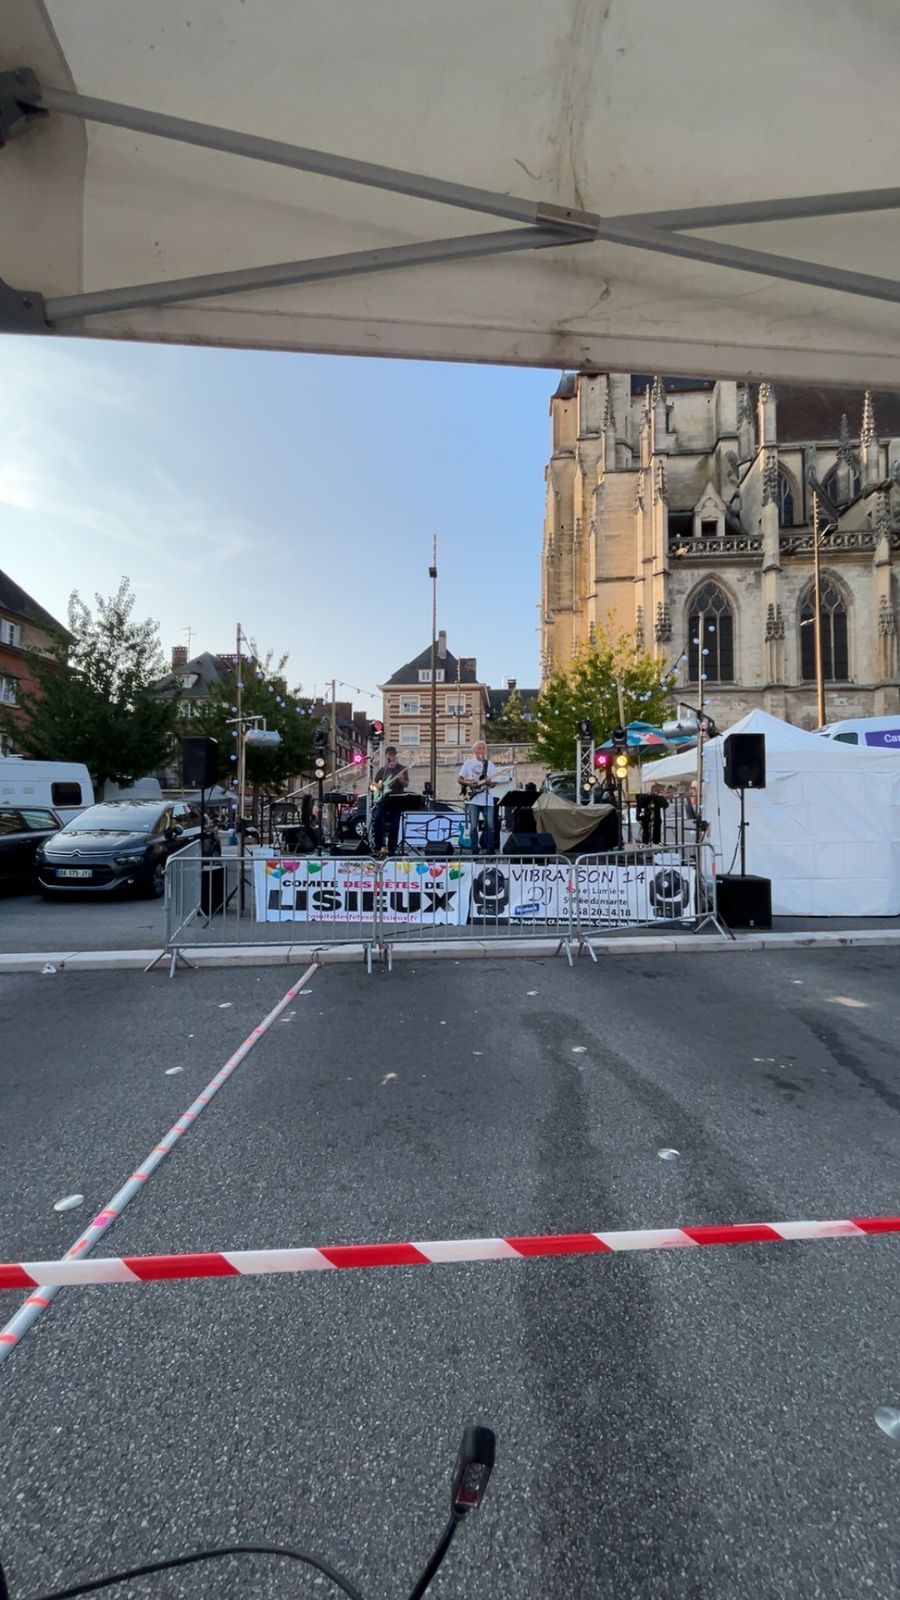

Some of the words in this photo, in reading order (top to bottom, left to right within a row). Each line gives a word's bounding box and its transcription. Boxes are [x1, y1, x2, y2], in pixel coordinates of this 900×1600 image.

[343, 880, 371, 889] DES
[376, 879, 420, 889] ÊTES
[425, 881, 444, 889] DE
[623, 871, 645, 883] 14
[268, 889, 457, 913] LISIEUX
[528, 887, 552, 905] DJ
